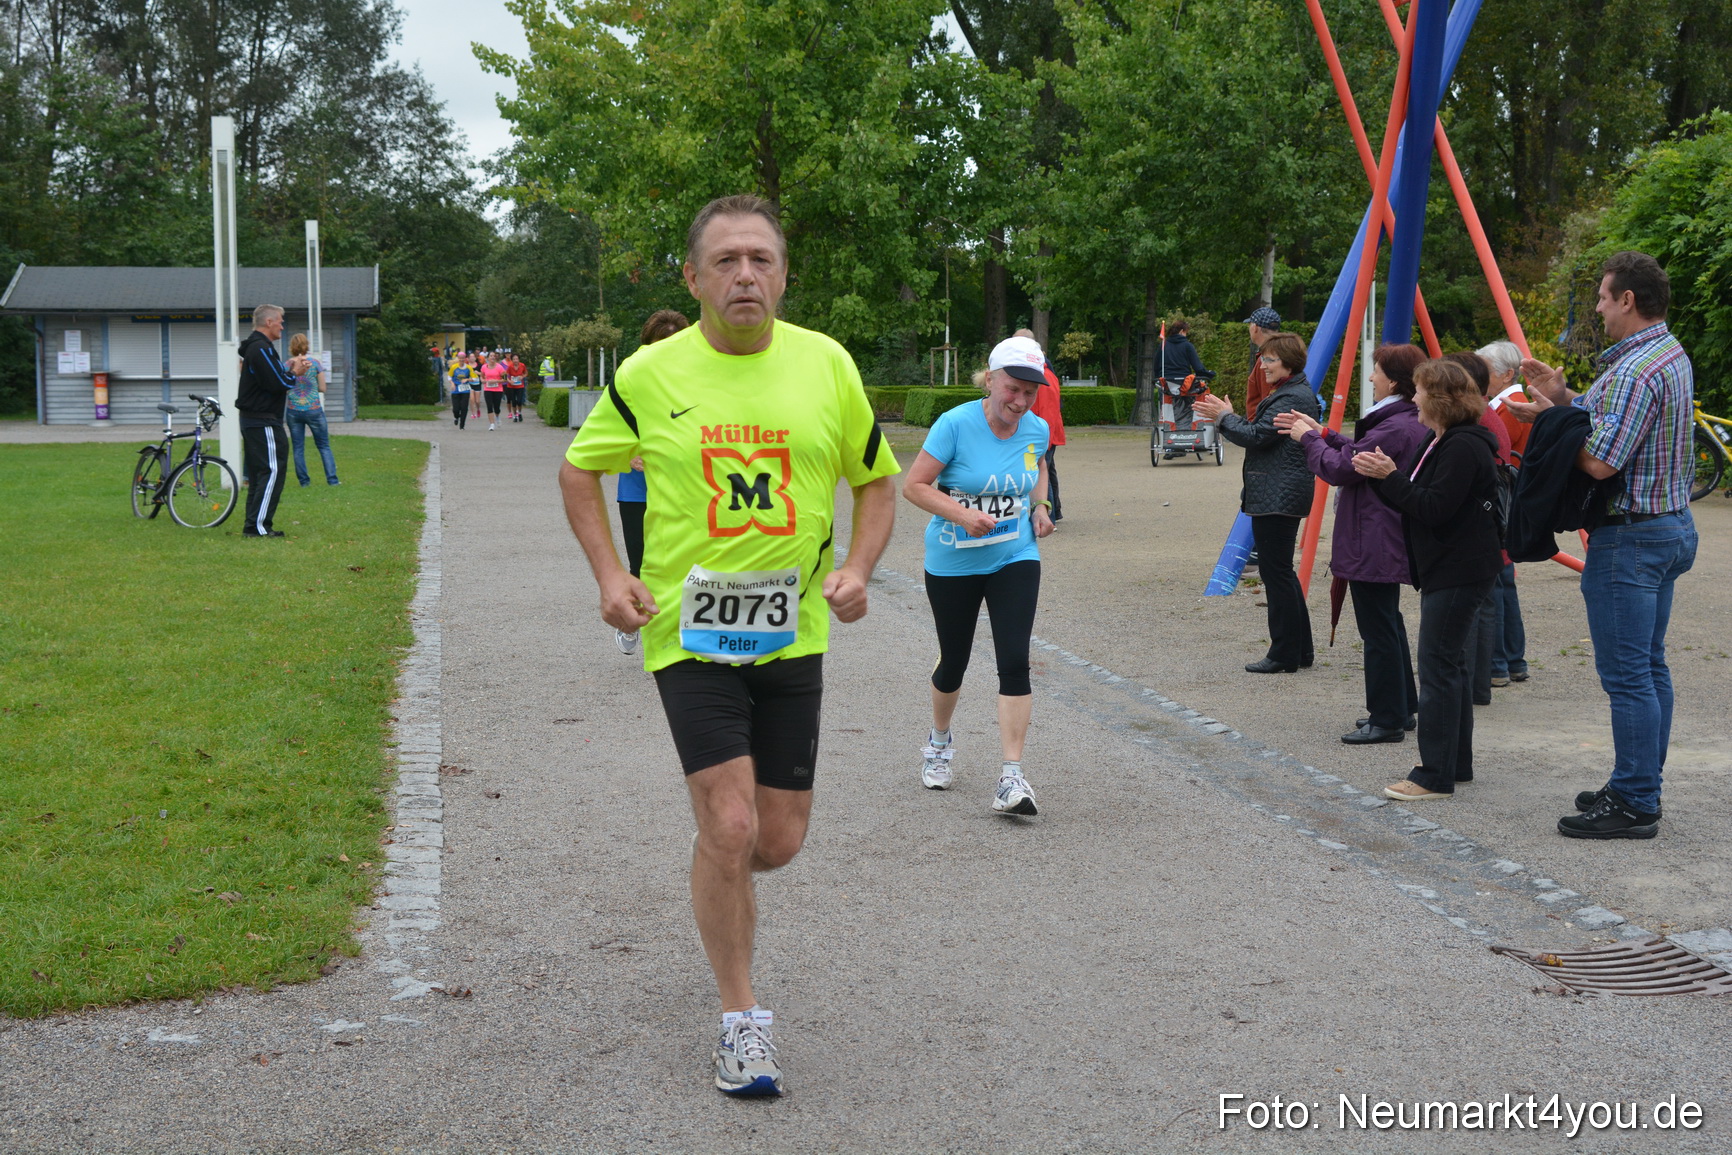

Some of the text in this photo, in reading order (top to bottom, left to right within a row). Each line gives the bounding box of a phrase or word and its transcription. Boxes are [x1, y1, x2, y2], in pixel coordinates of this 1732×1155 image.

[700, 424, 790, 444] Müller
[726, 472, 774, 511] M
[687, 574, 780, 591] PARTL Neumarkt
[692, 591, 789, 627] 2073
[718, 635, 759, 652] Peter
